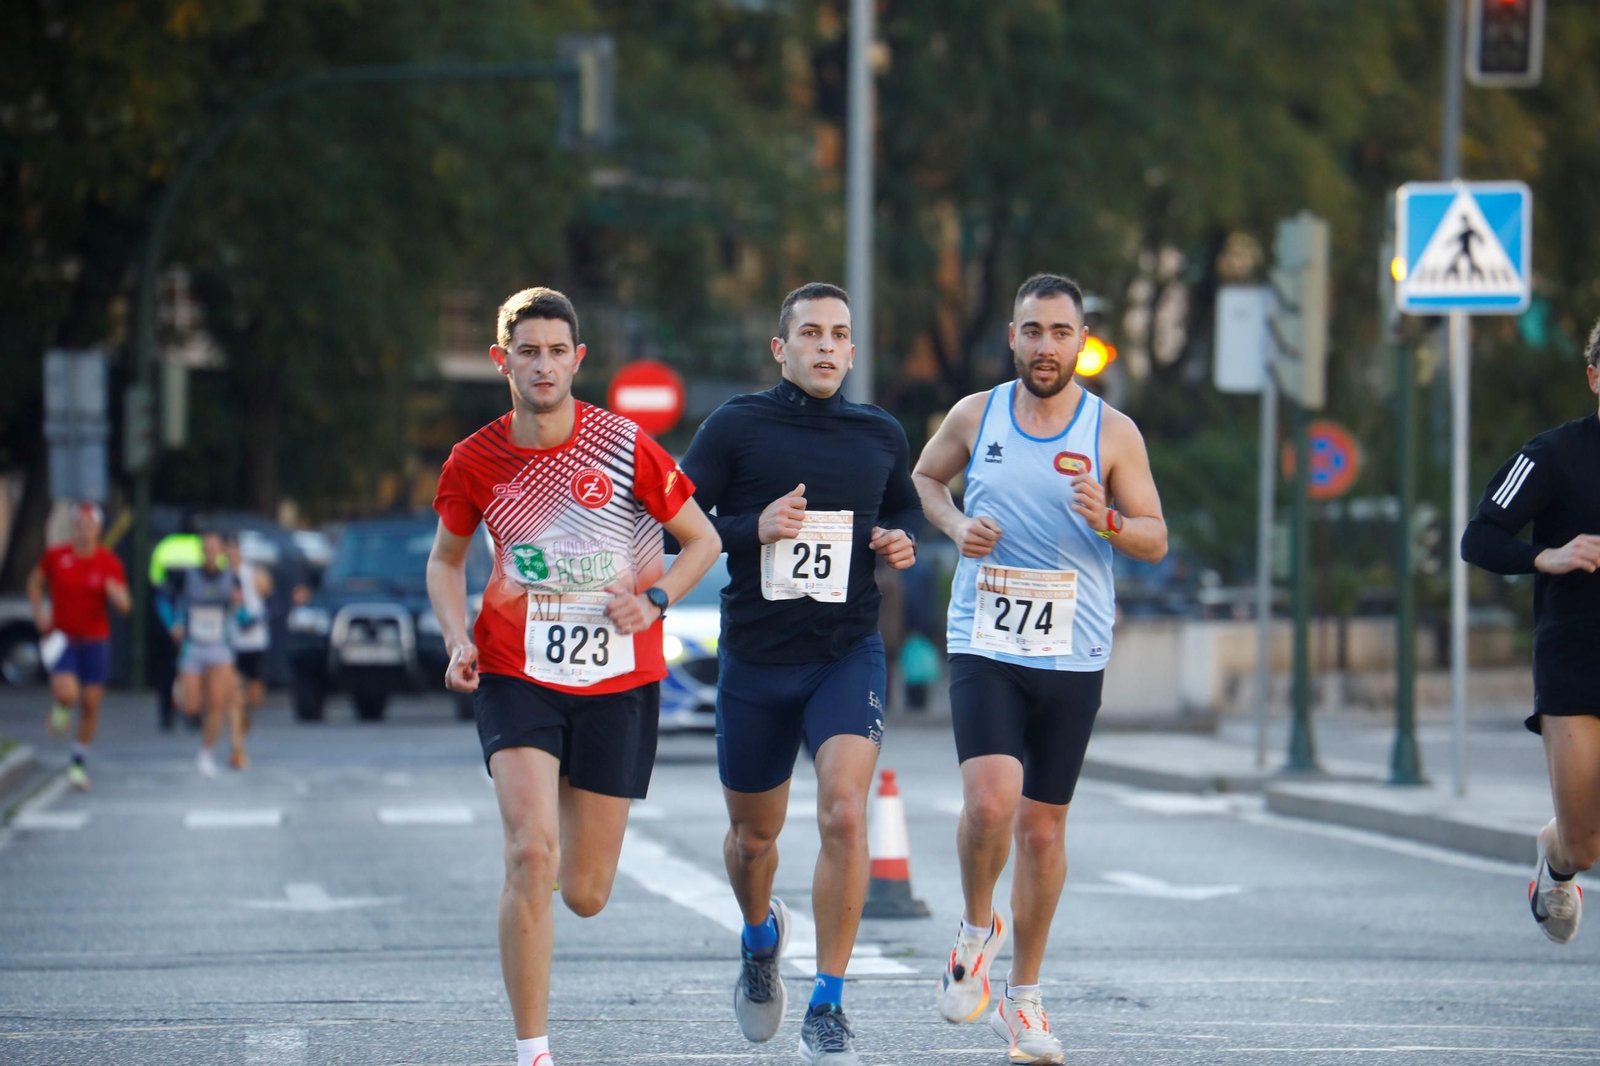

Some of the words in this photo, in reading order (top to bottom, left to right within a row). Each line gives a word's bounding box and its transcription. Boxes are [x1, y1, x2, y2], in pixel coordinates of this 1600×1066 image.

[792, 542, 832, 579] 25
[531, 594, 564, 622] XLI
[995, 596, 1053, 635] 274
[546, 624, 609, 667] 823
